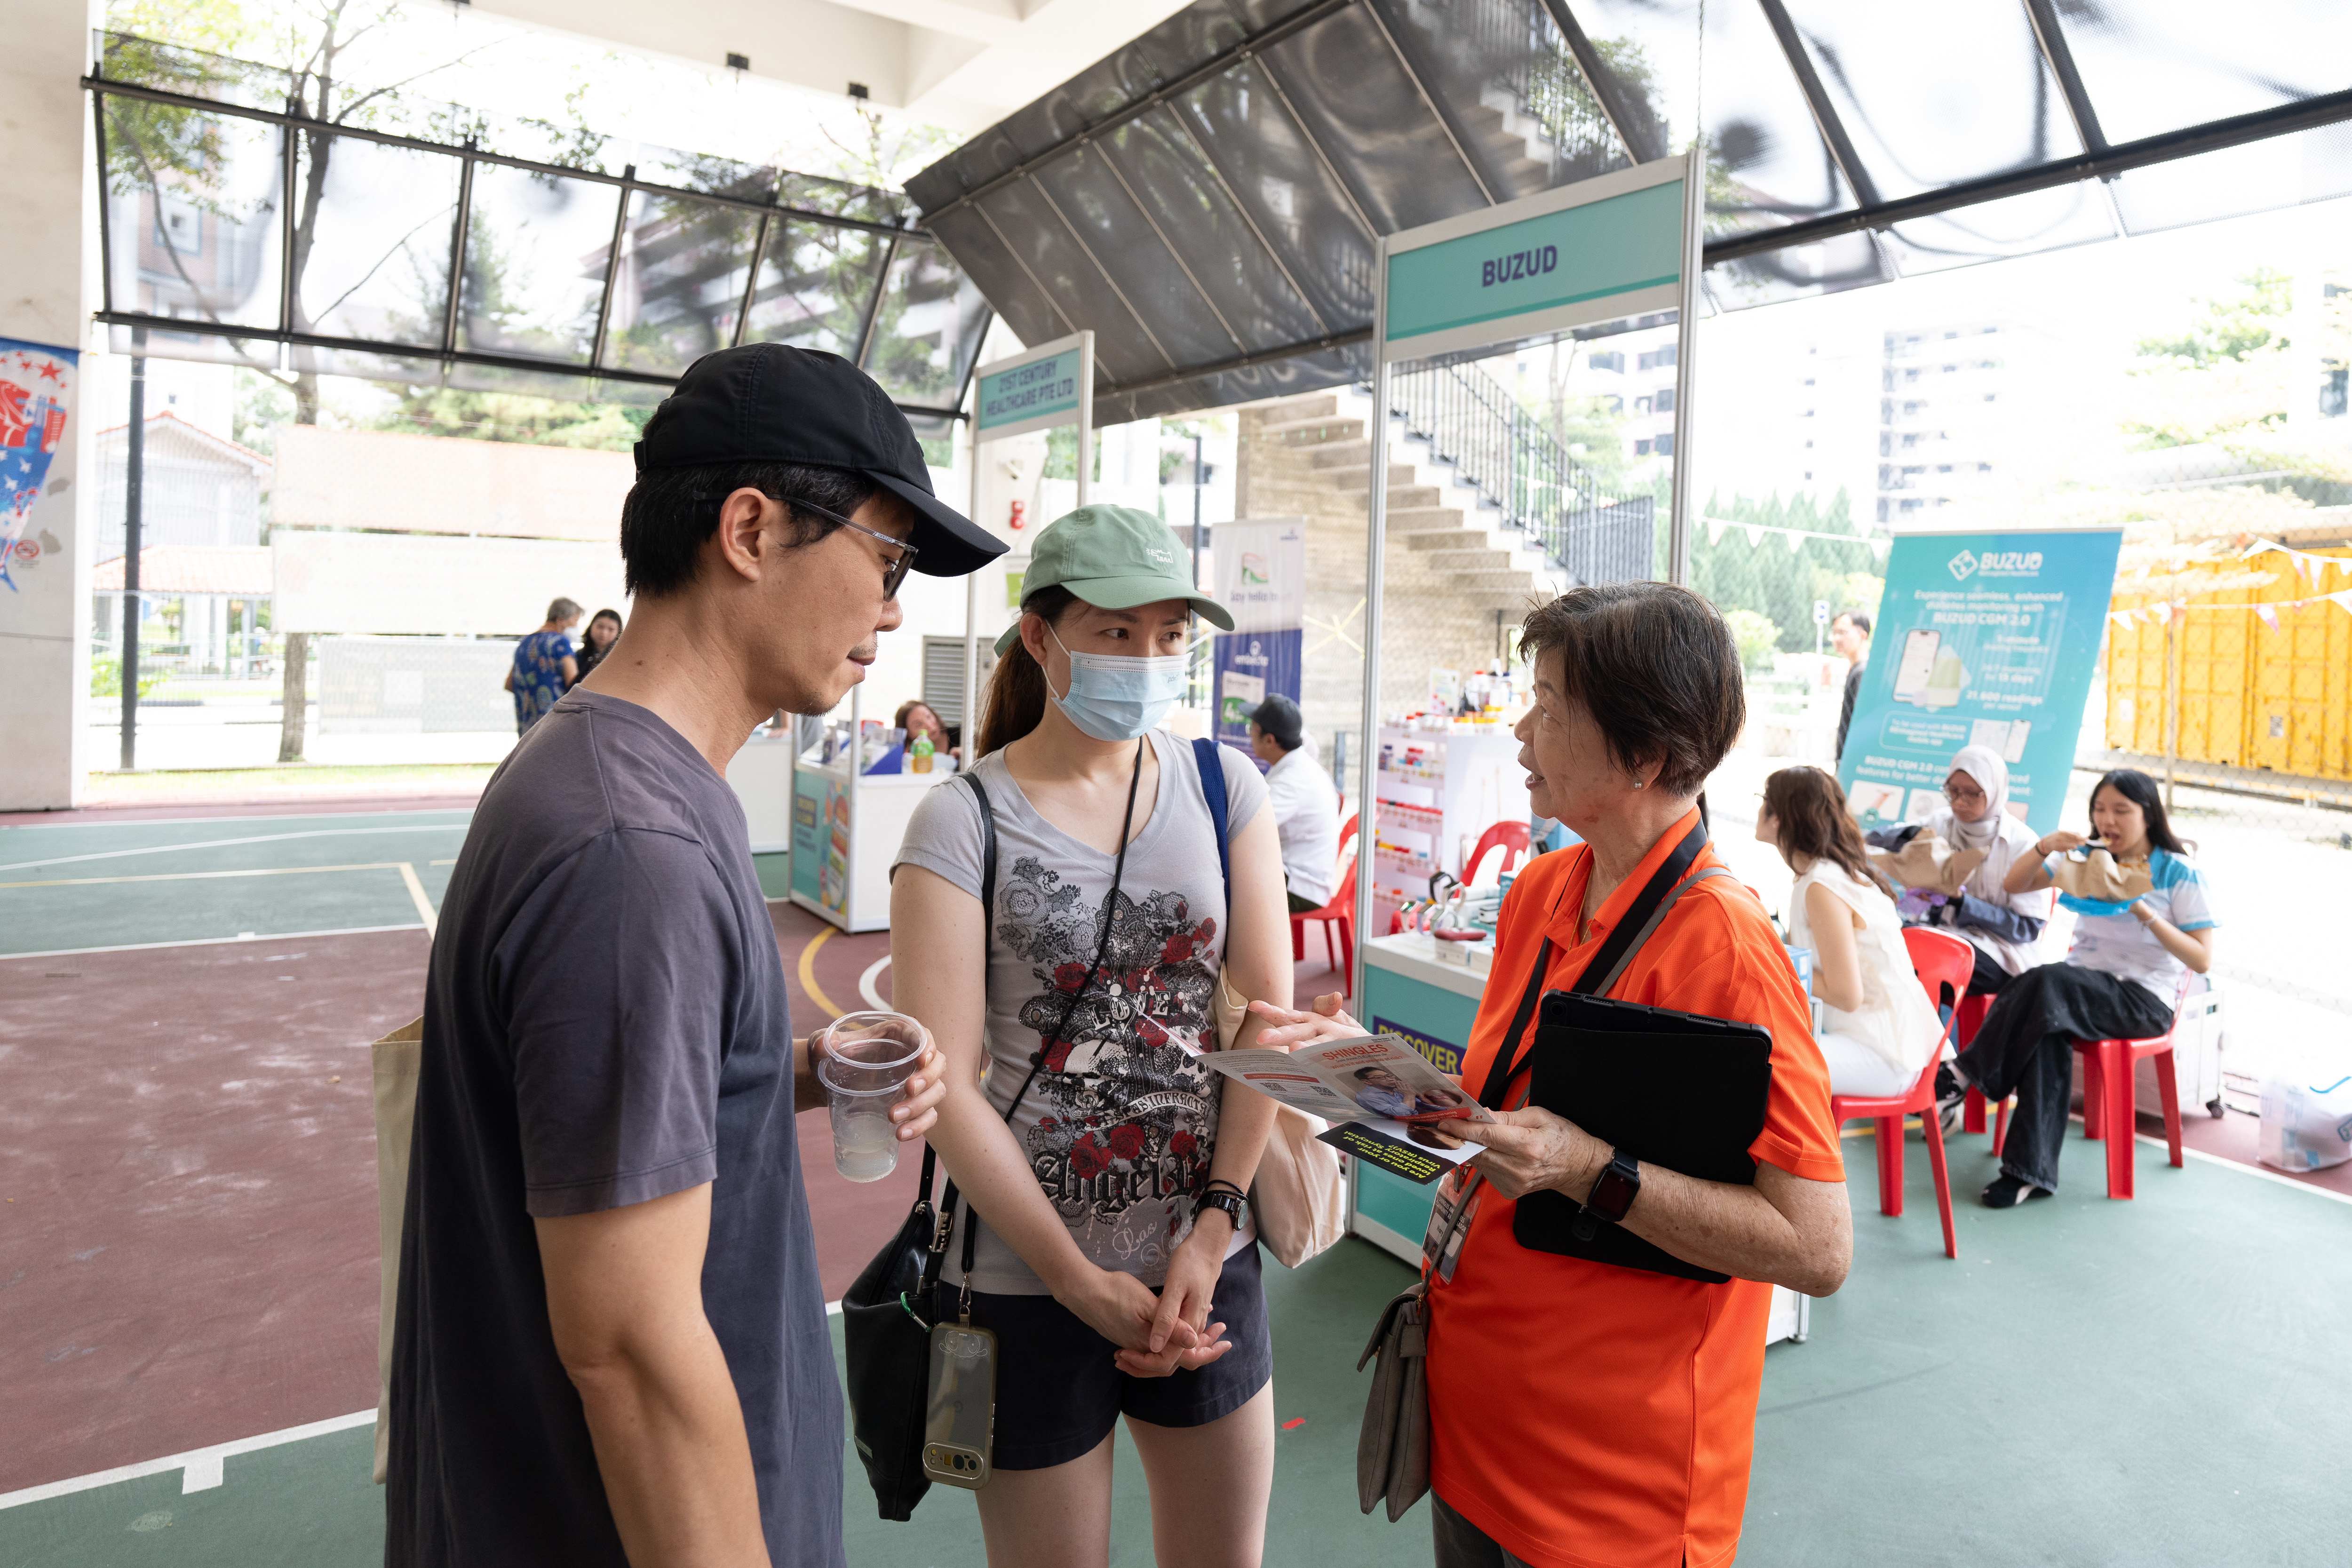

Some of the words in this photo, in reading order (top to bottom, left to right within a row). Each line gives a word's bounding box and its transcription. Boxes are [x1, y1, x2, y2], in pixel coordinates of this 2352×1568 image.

[1482, 245, 1558, 288] BUZUD
[1000, 373, 1017, 392] 21ST
[1019, 361, 1057, 386] CENTURY
[987, 389, 1036, 415] HEALTHCARE
[1039, 382, 1055, 402] PTE
[1057, 377, 1073, 398] LTD
[1979, 552, 2043, 570] BUZUD
[1933, 612, 1976, 624] BUZUD
[1977, 613, 2008, 625] CGM
[2010, 614, 2031, 626] 2.0
[1085, 991, 1171, 1031] LOVE
[1322, 1044, 1388, 1060] SHINGLES
[1378, 1024, 1458, 1075] OVER
[1343, 1131, 1384, 1149] Syncytial
[1355, 1140, 1372, 1149] risk
[1358, 1147, 1380, 1158] your
[1384, 1154, 1404, 1163] ones
[1388, 1145, 1417, 1158] (RSV)?
[1384, 1148, 1436, 1172] Respiratory
[1391, 1162, 1409, 1173] you
[1418, 1156, 1440, 1169] Virus
[1404, 1162, 1431, 1175] loved
[1409, 1169, 1426, 1178] Are
[1435, 1201, 1448, 1217] COMMUNITY
[1438, 1196, 1450, 1210] SHINGLES
[1112, 1222, 1157, 1260] Las
